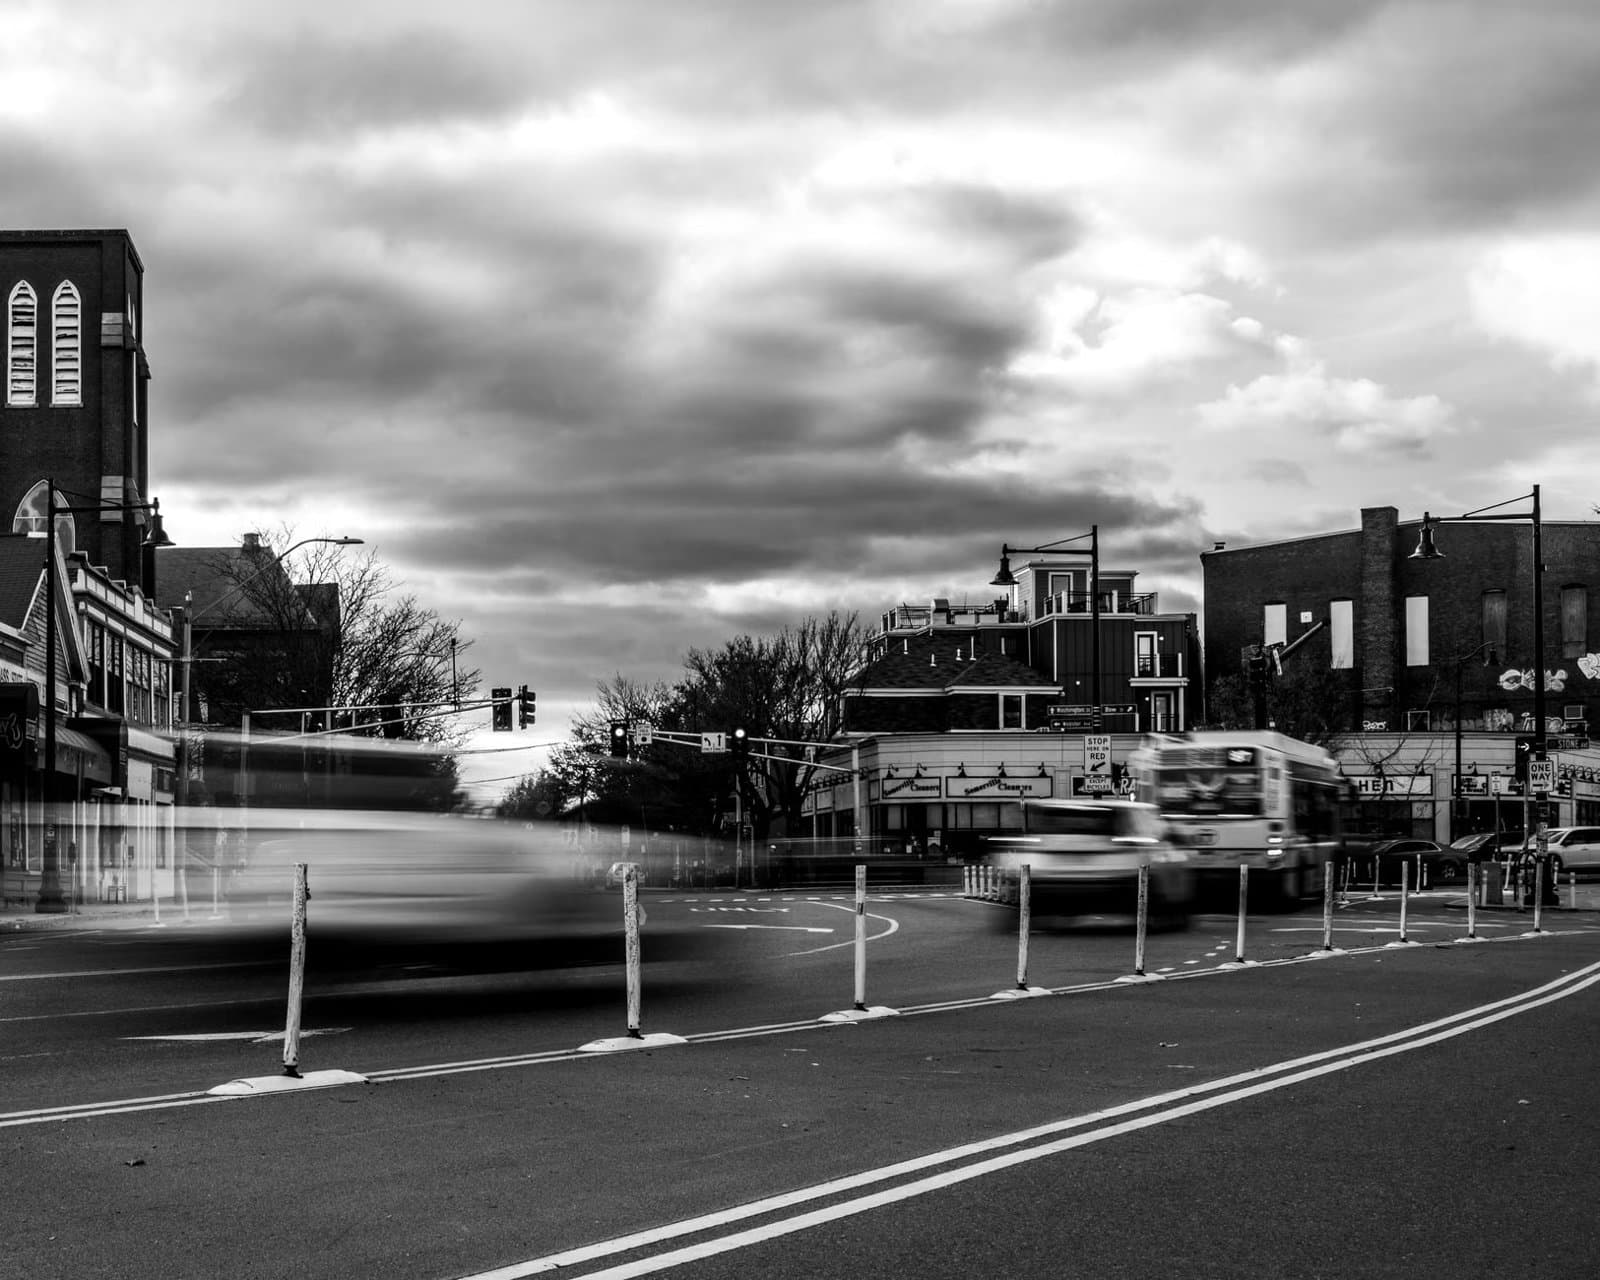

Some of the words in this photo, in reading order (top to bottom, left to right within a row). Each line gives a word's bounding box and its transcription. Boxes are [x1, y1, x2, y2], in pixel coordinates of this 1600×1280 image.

[1087, 737, 1108, 745] STOP
[1530, 764, 1551, 773] ONE
[1530, 773, 1552, 781] WAY
